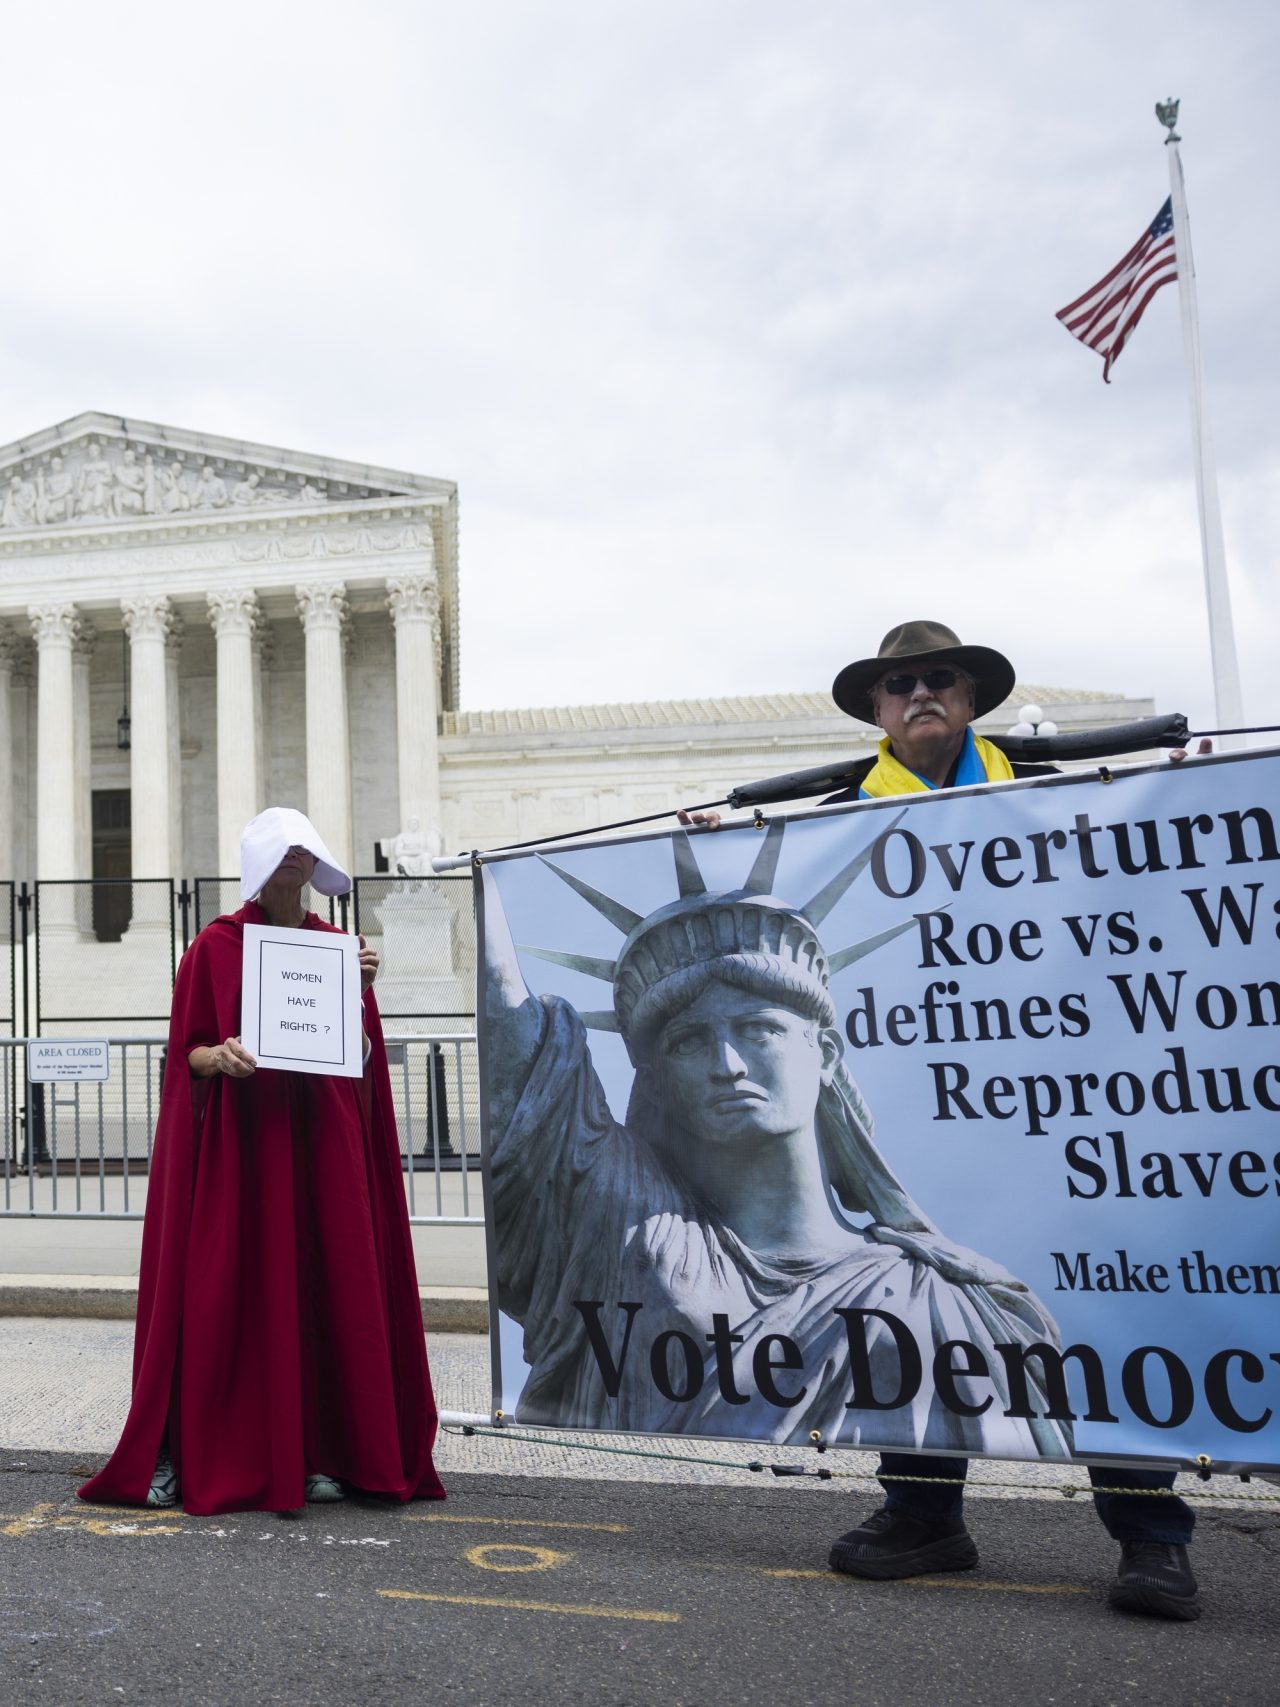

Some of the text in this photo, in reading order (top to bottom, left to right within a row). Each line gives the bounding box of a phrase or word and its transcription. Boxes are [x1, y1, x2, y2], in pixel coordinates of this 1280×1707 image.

[869, 805, 1280, 899] Overturn
[912, 882, 1280, 969] Roe vs. W
[281, 970, 322, 984] WOMEN
[287, 996, 317, 1008] HAVE
[280, 1020, 318, 1033] RIGHTS
[844, 980, 1091, 1050] defines
[37, 1047, 102, 1057] AREA CLOSED
[1064, 1130, 1280, 1199] Slave
[1050, 1250, 1170, 1293] Make
[573, 1301, 1280, 1434] Vote Democ
